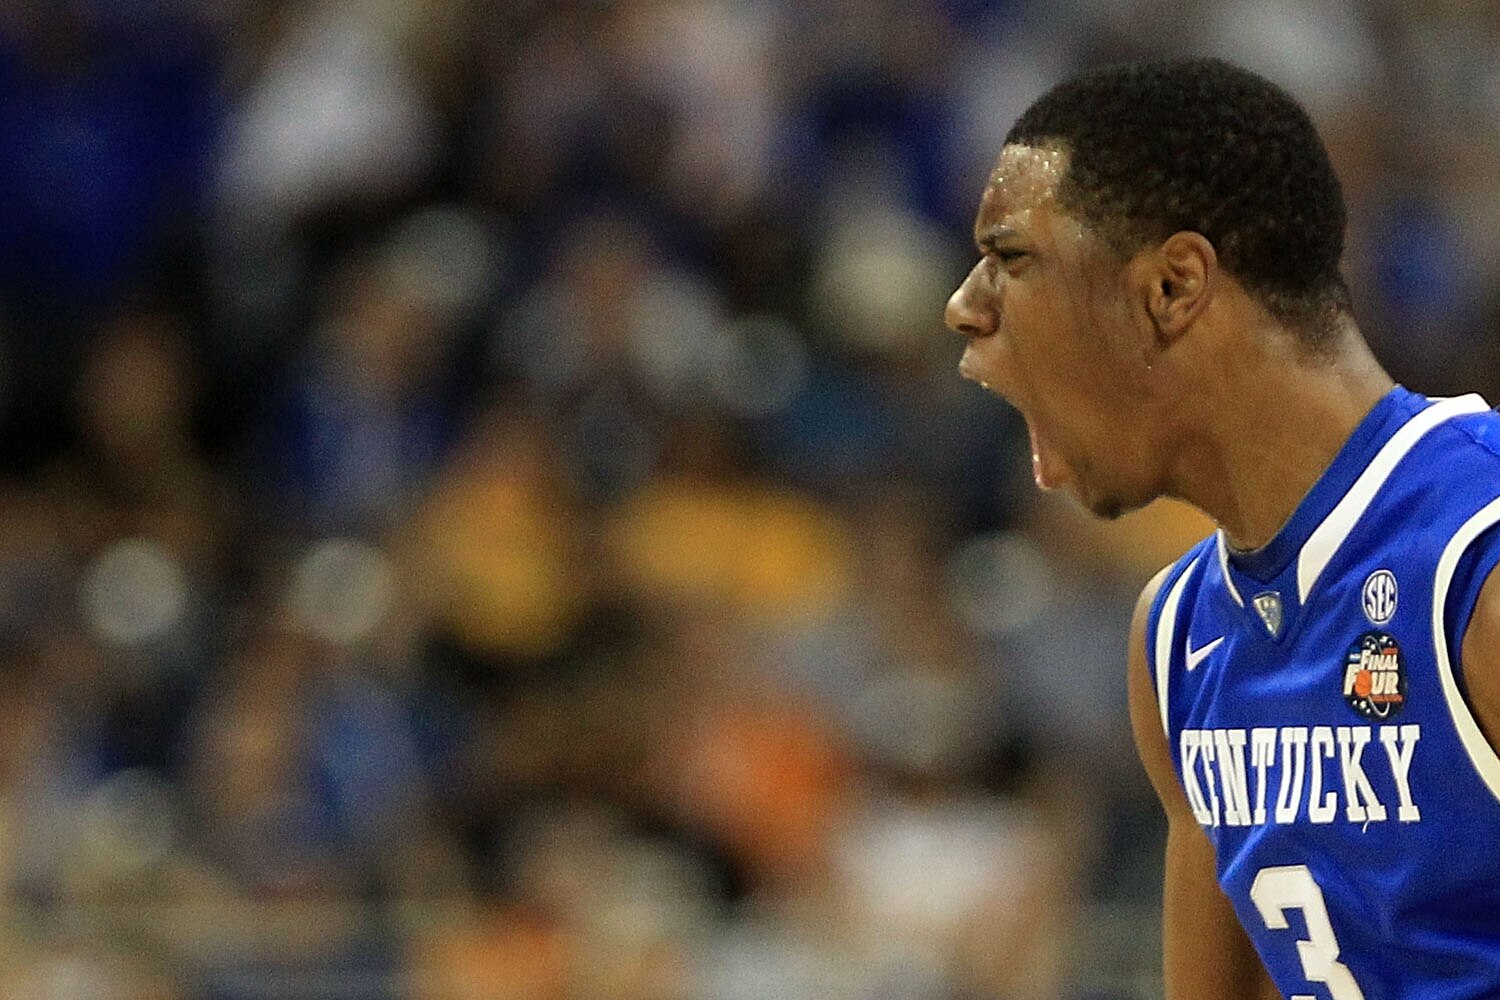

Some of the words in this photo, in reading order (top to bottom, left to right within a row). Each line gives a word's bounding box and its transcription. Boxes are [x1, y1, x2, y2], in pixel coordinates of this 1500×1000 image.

[1365, 574, 1395, 620] SEC
[1360, 650, 1399, 671] FINAL
[1180, 725, 1421, 827] KENTUCKY
